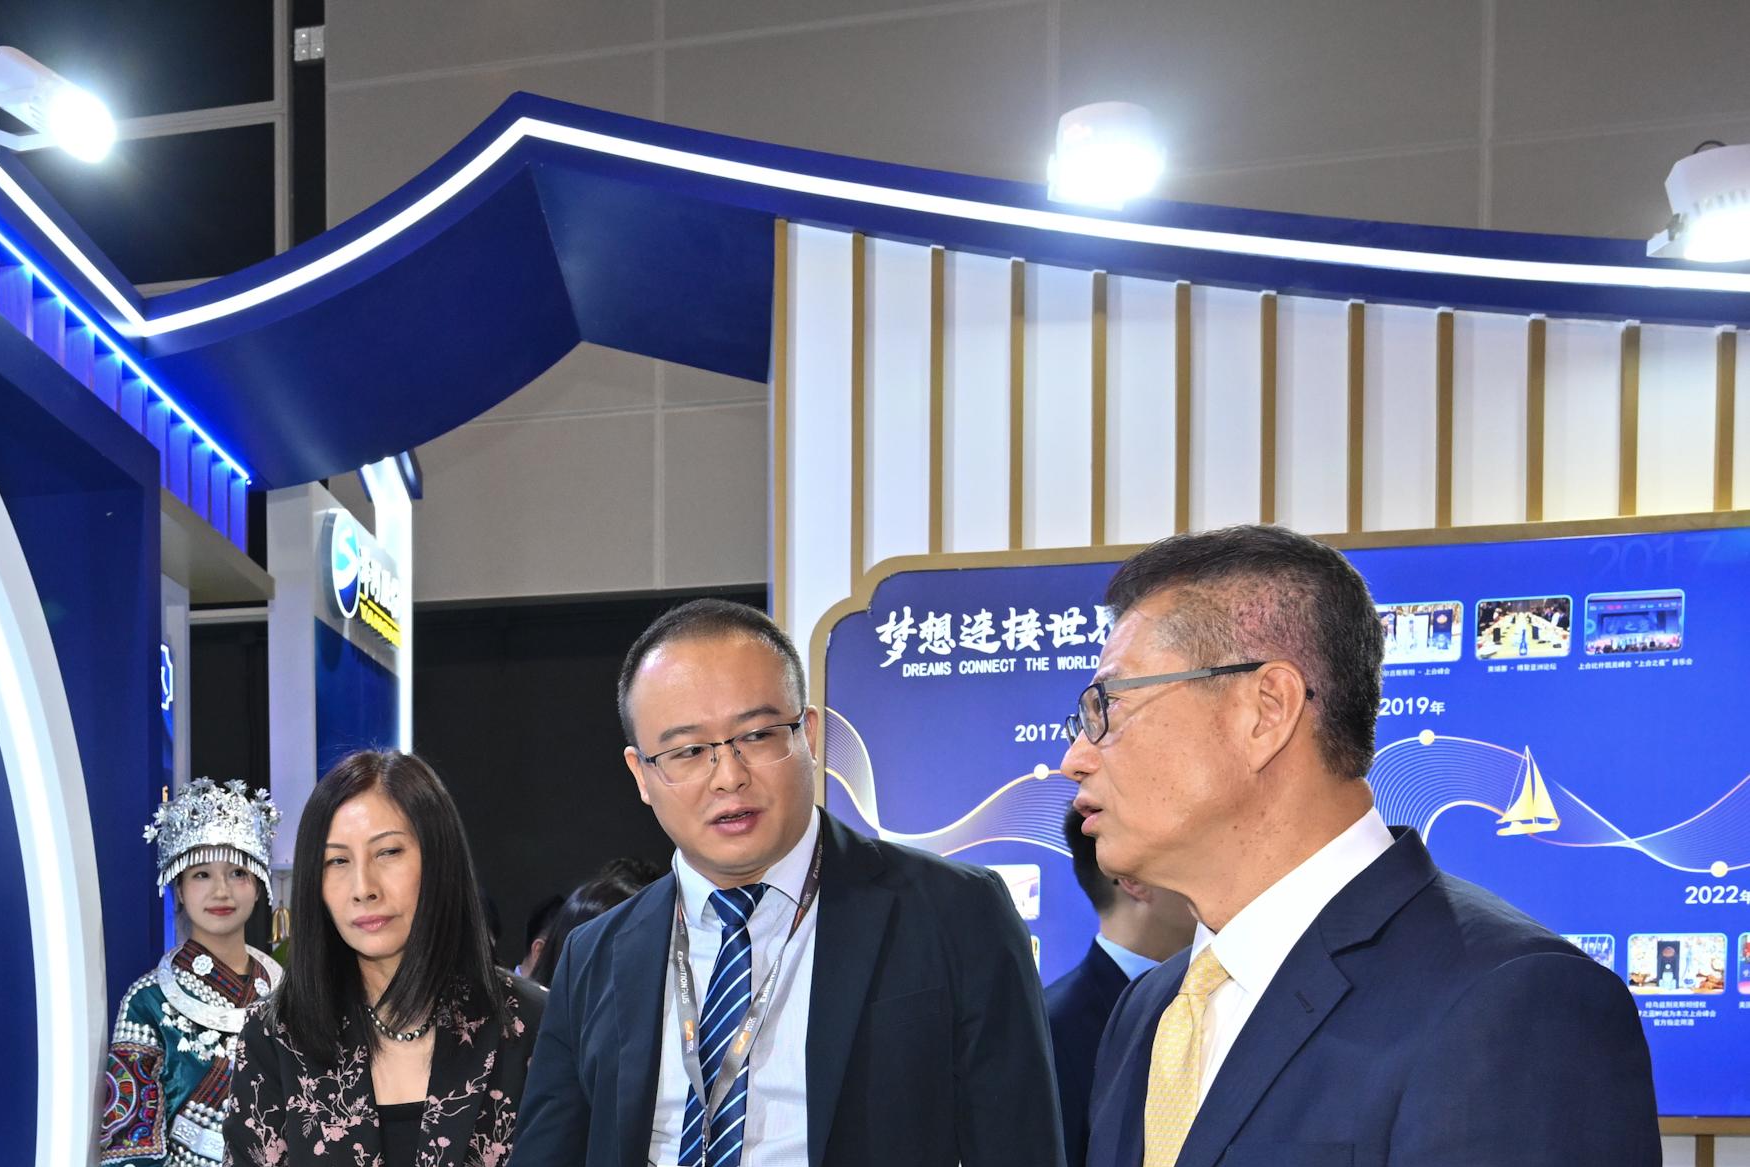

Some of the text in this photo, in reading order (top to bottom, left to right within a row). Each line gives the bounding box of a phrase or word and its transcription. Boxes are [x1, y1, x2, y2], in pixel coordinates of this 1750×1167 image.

[902, 655, 1100, 677] DREAMS CONNECT THE WORLD
[1379, 696, 1446, 716] 2019年
[1014, 722, 1069, 742] 2017
